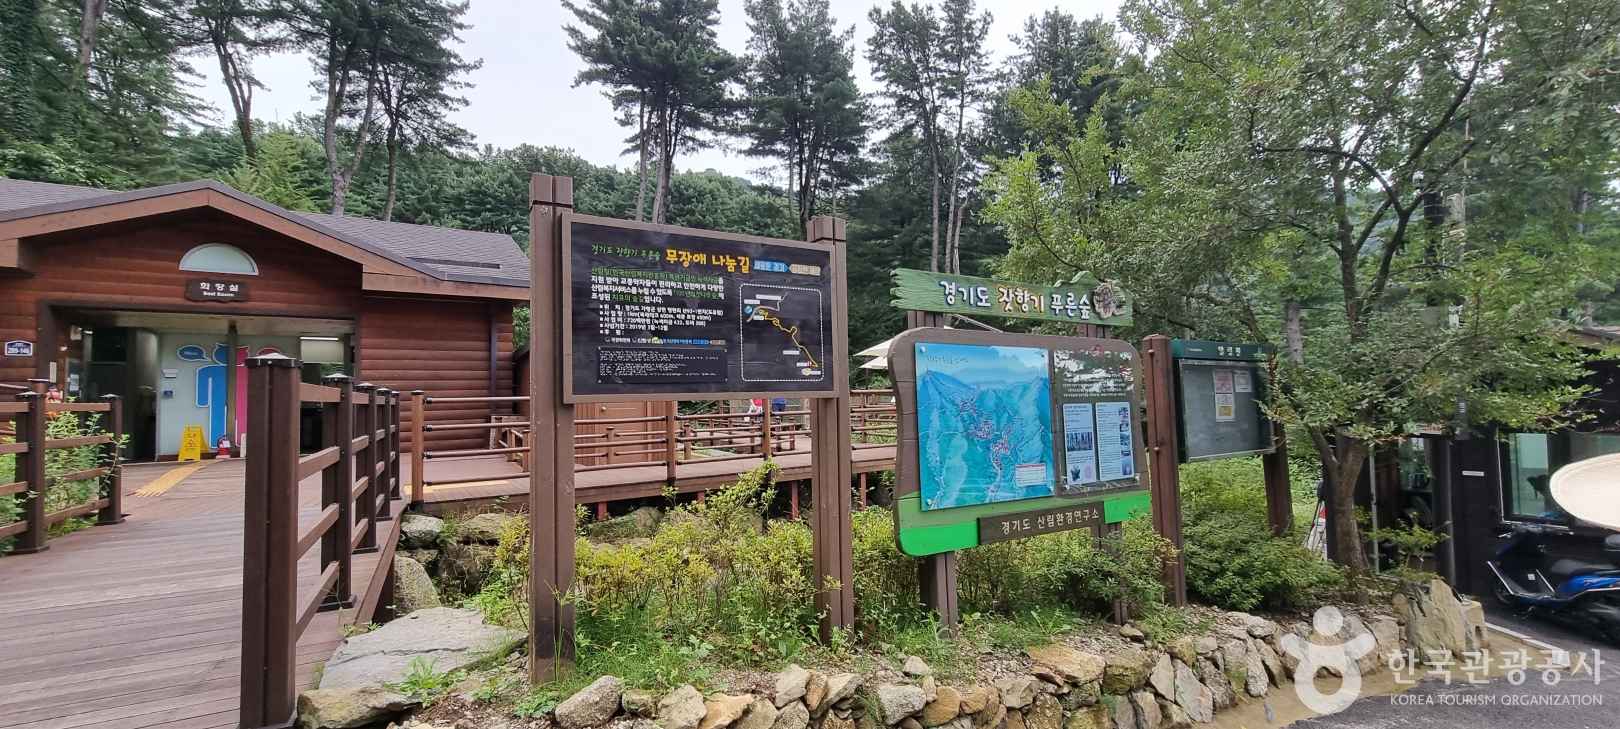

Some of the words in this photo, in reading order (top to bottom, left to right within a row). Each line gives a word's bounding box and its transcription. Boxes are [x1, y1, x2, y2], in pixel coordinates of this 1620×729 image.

[666, 249, 707, 268] 무장애
[711, 254, 750, 273] 나눔길
[940, 280, 991, 308] 경기도
[998, 288, 1045, 314] 잣향기
[1050, 292, 1092, 320] 푸른숲
[1001, 518, 1031, 535] 경기도
[1037, 507, 1099, 529] 산림환경연구소
